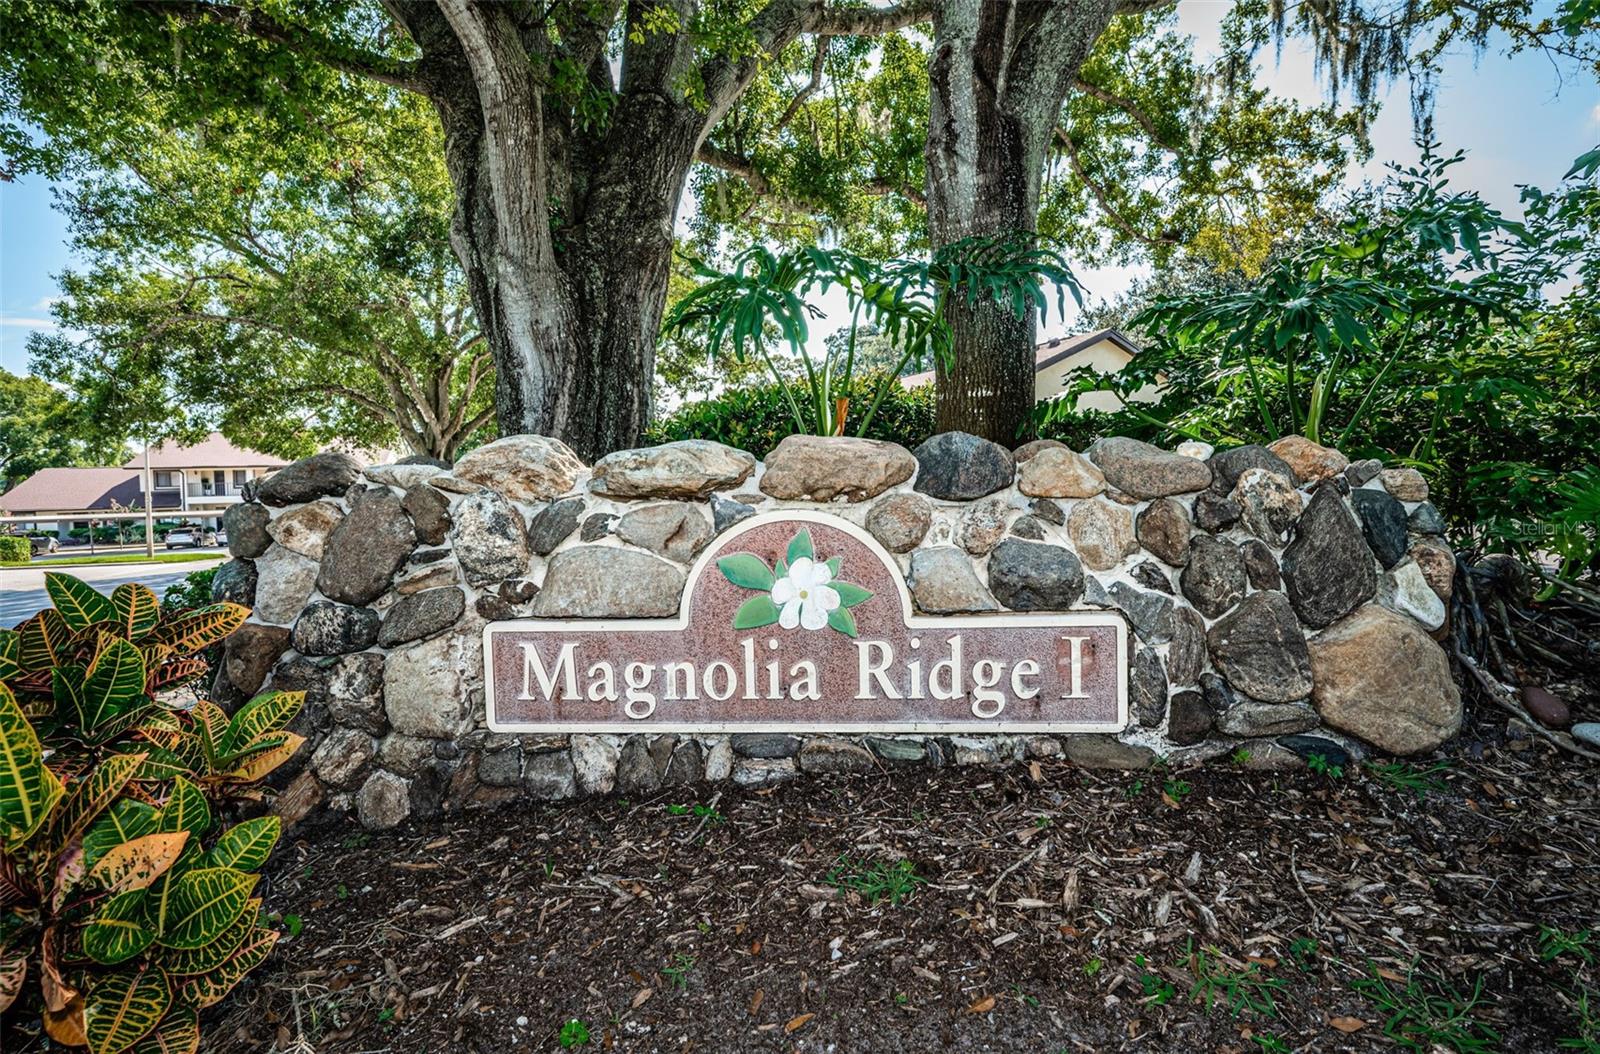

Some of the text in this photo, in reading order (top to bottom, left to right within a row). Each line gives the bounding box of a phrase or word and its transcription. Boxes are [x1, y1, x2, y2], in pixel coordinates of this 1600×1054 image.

[518, 634, 1092, 720] Magnolia Ridge I
